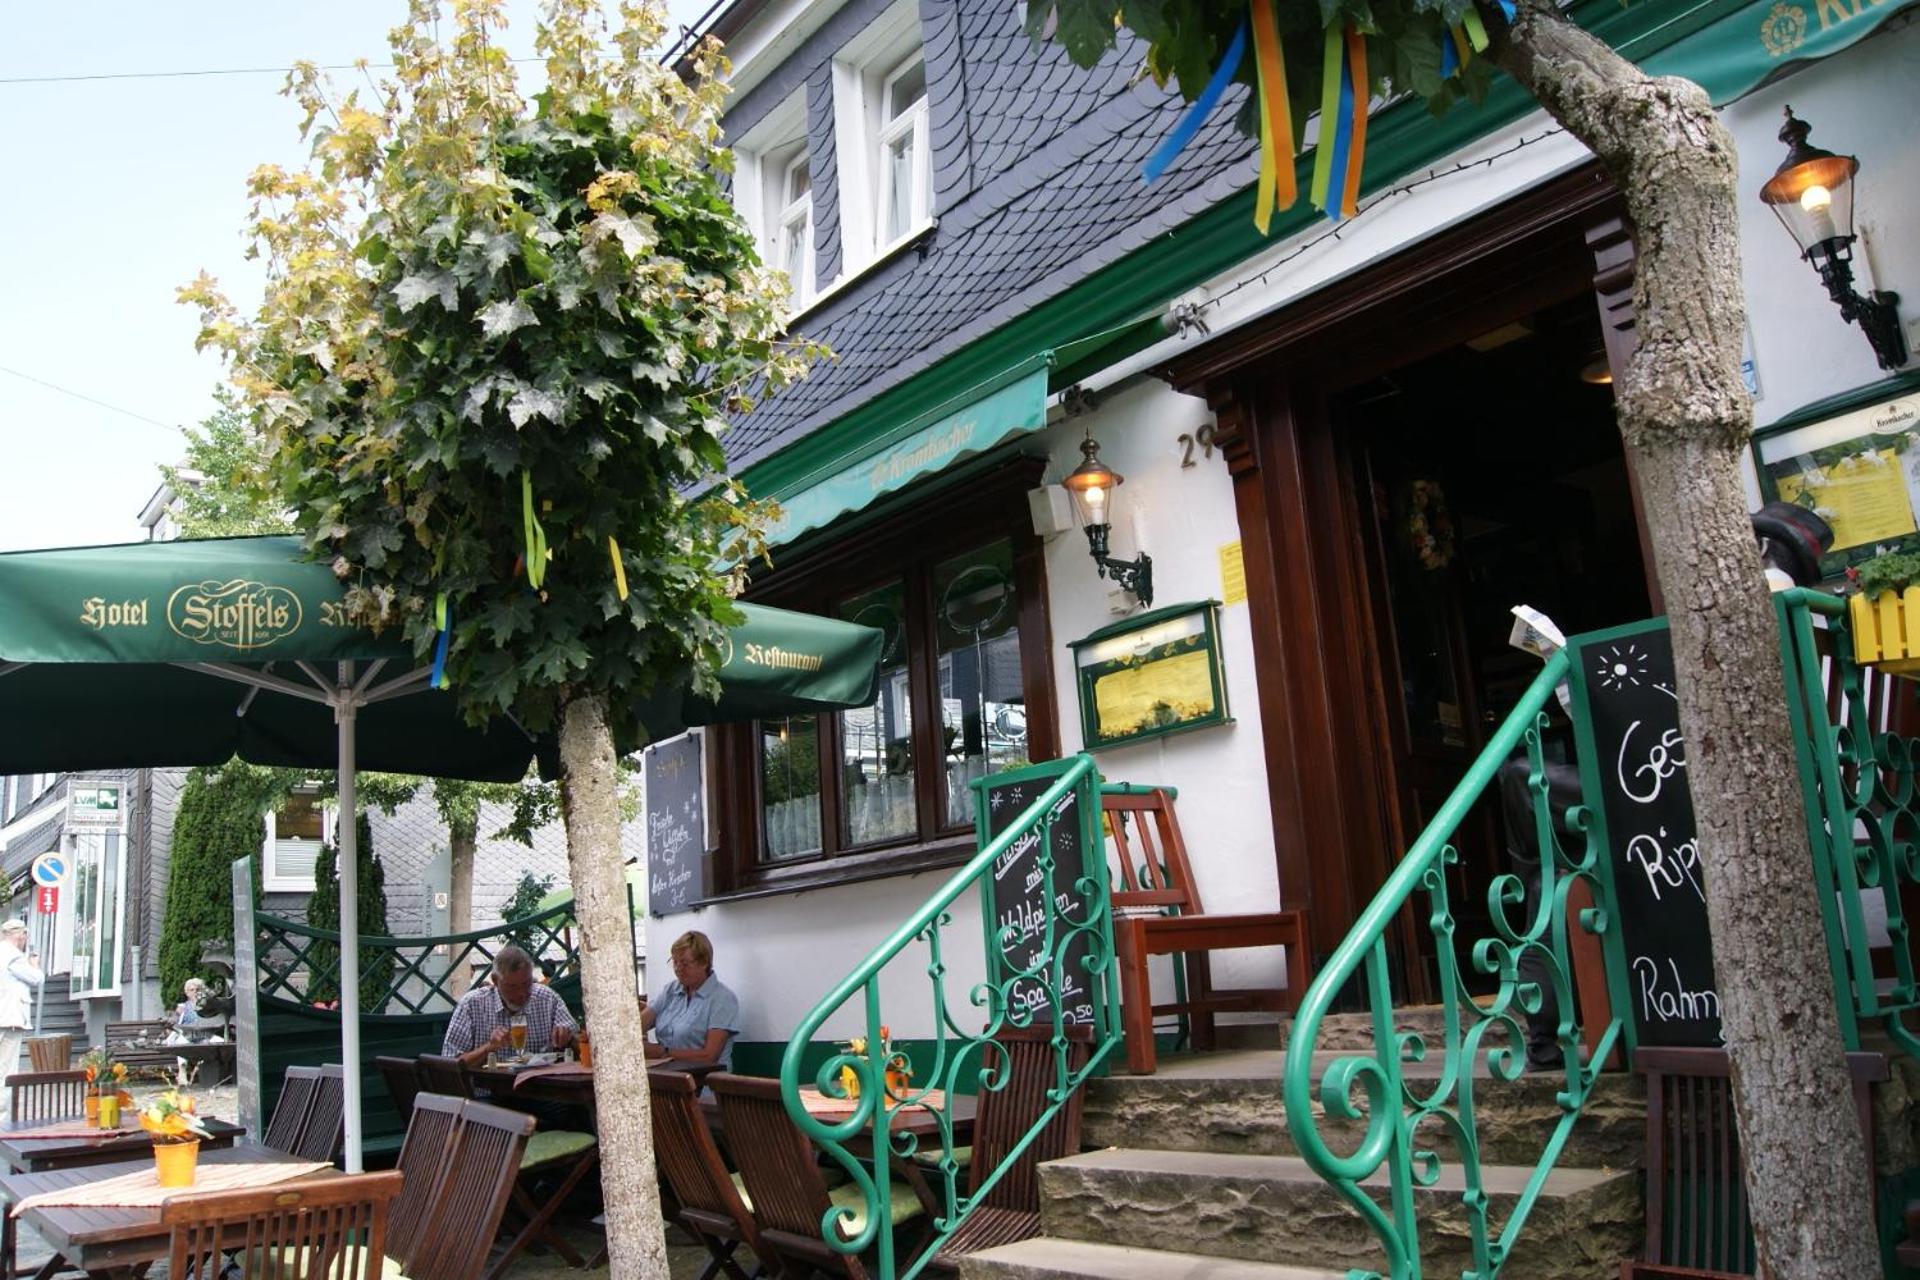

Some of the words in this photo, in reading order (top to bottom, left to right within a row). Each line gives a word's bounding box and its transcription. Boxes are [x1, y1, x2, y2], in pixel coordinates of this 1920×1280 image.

[1177, 424, 1214, 468] 29
[80, 596, 148, 630] Hotel
[181, 592, 290, 652] Stoffels
